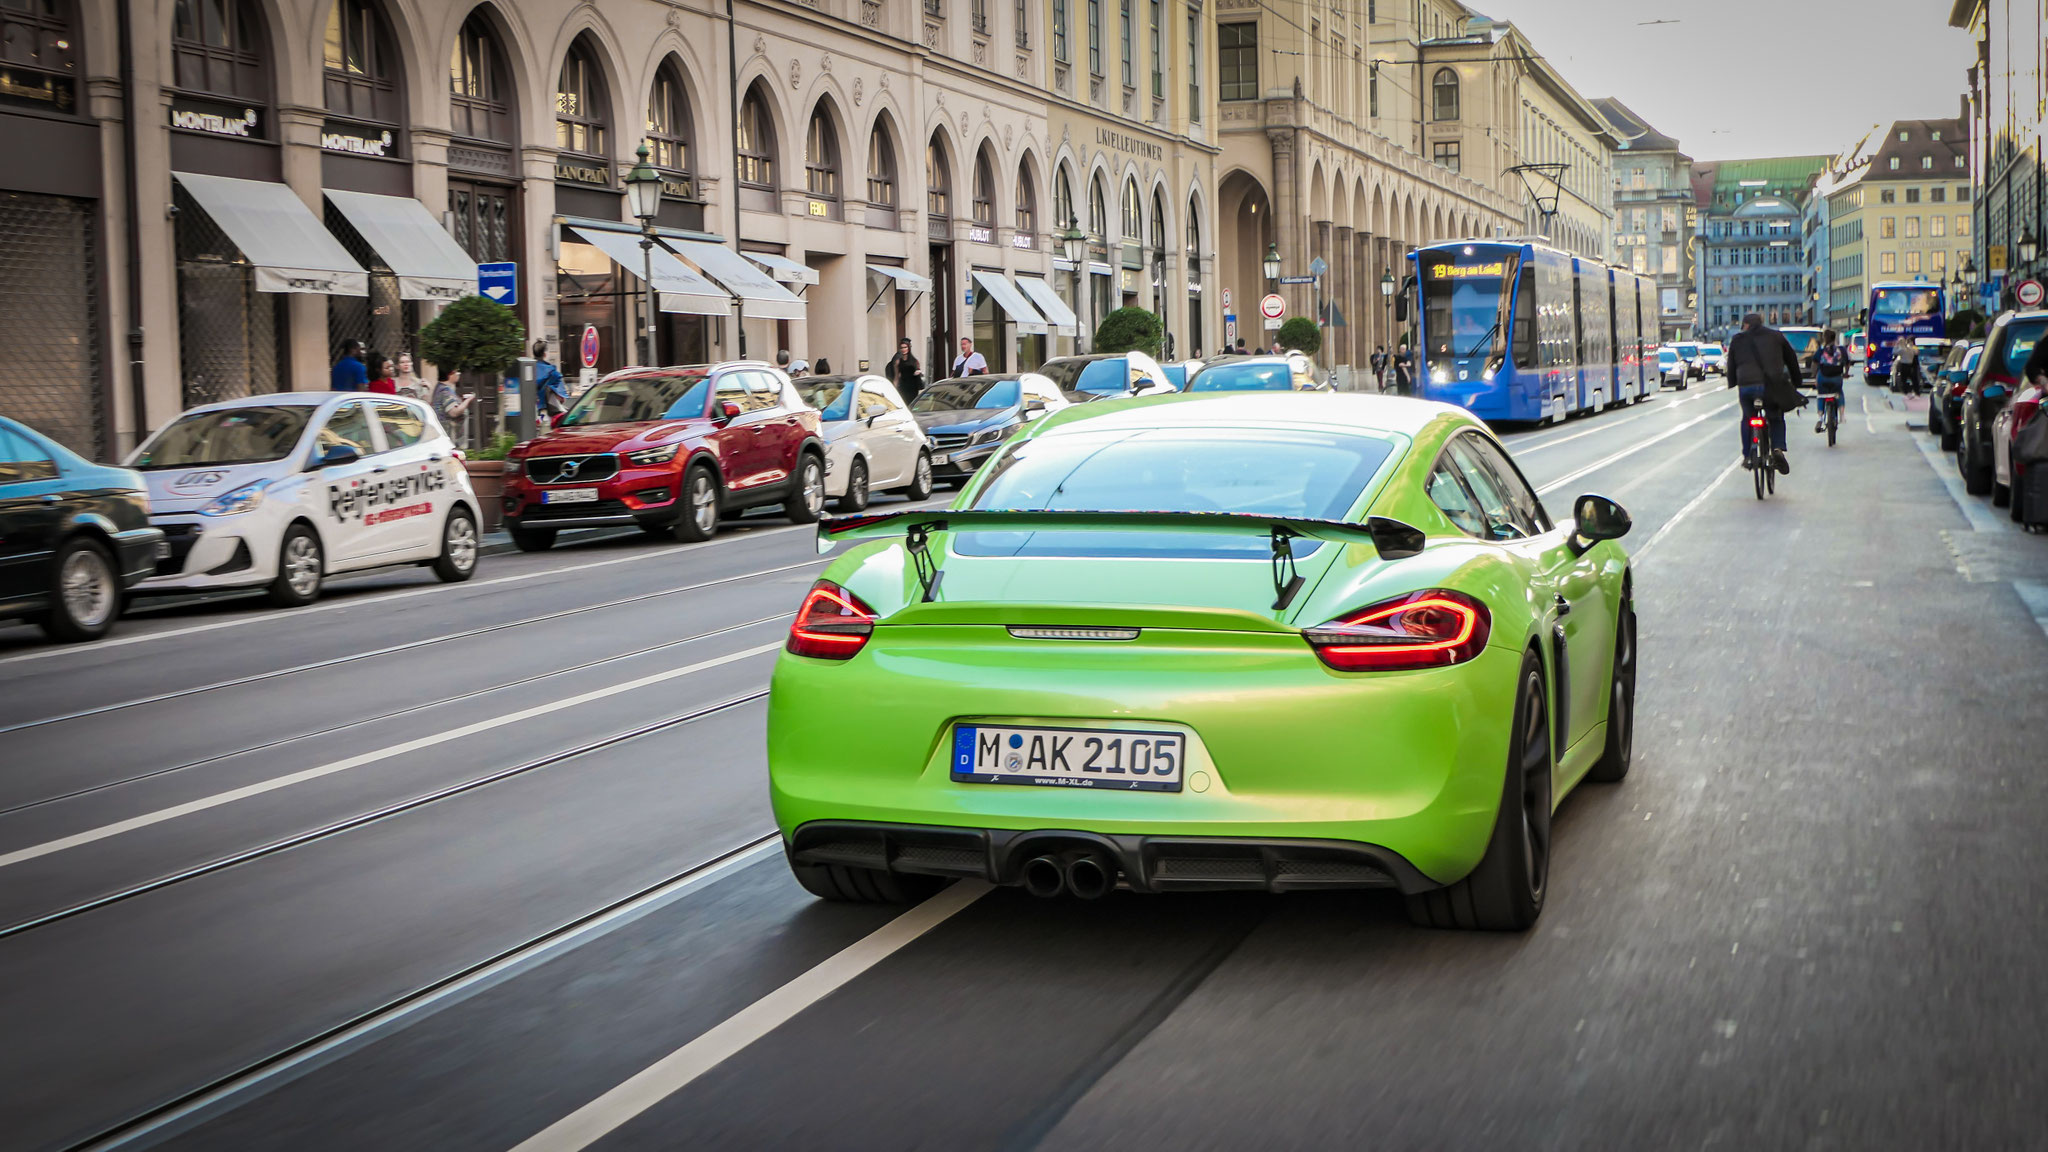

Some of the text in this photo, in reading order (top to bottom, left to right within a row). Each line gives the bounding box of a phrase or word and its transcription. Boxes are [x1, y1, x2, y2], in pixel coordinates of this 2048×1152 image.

[172, 110, 249, 136] MONTBLANC
[321, 133, 385, 156] MONTBLANC
[554, 164, 610, 184] LANCPAIN
[969, 228, 990, 243] HUBLOT
[1432, 264, 1446, 278] 19
[1447, 265, 1466, 277] Berg
[960, 732, 1177, 776] D M AK 2105
[1034, 777, 1094, 787] www.M-XL.de
